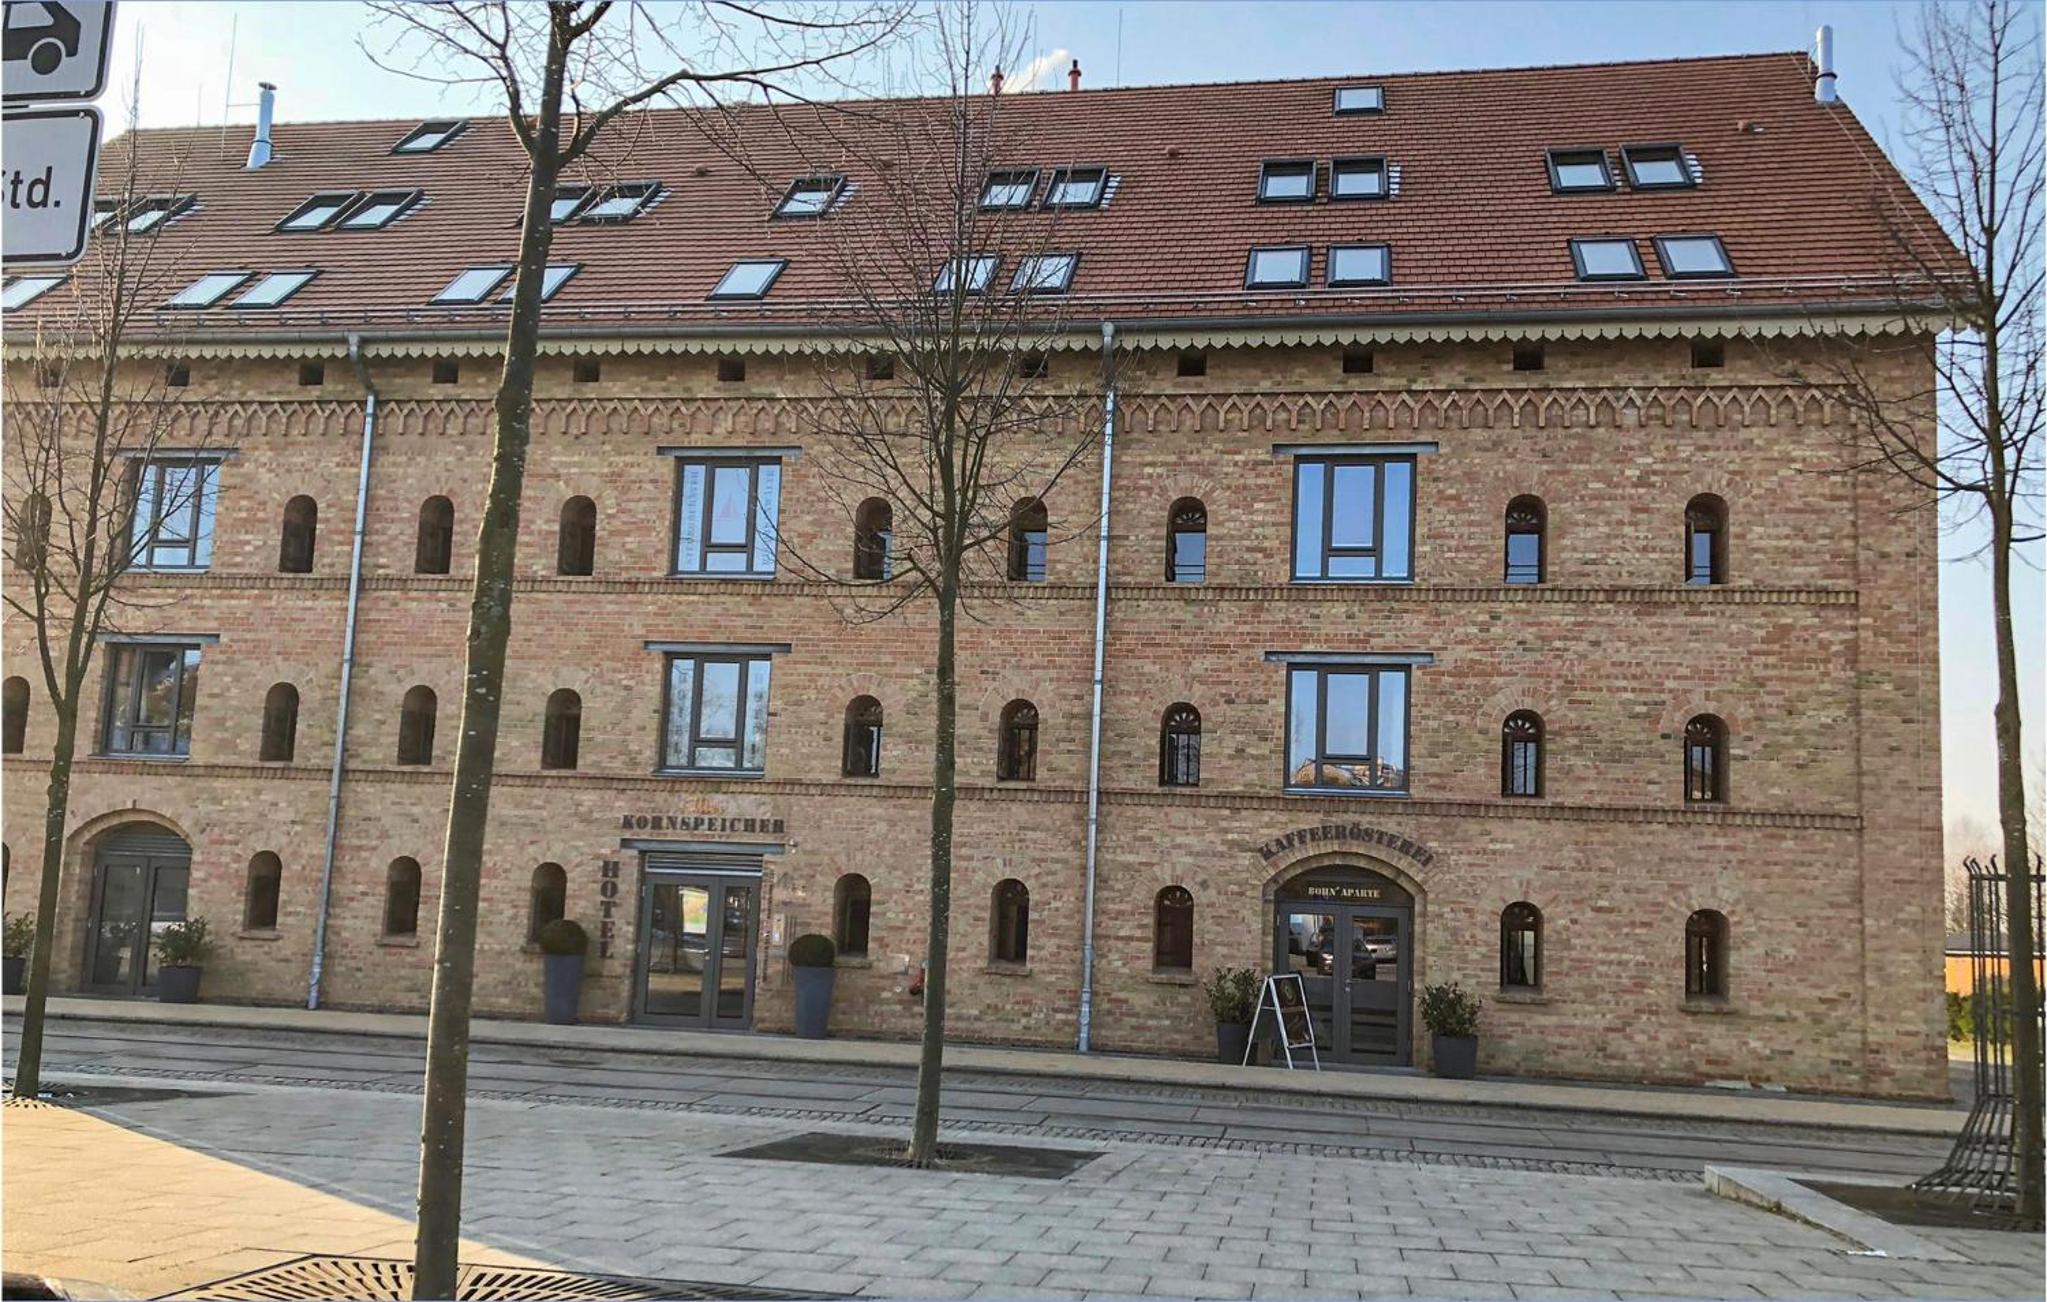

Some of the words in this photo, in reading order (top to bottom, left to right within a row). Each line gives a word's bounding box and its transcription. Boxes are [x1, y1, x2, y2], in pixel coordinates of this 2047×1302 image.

[2, 166, 61, 209] td.
[621, 814, 785, 834] KORNSPEICHER
[1258, 822, 1434, 866] KAFFEERÖSTEREI
[600, 860, 619, 958] HOTEL
